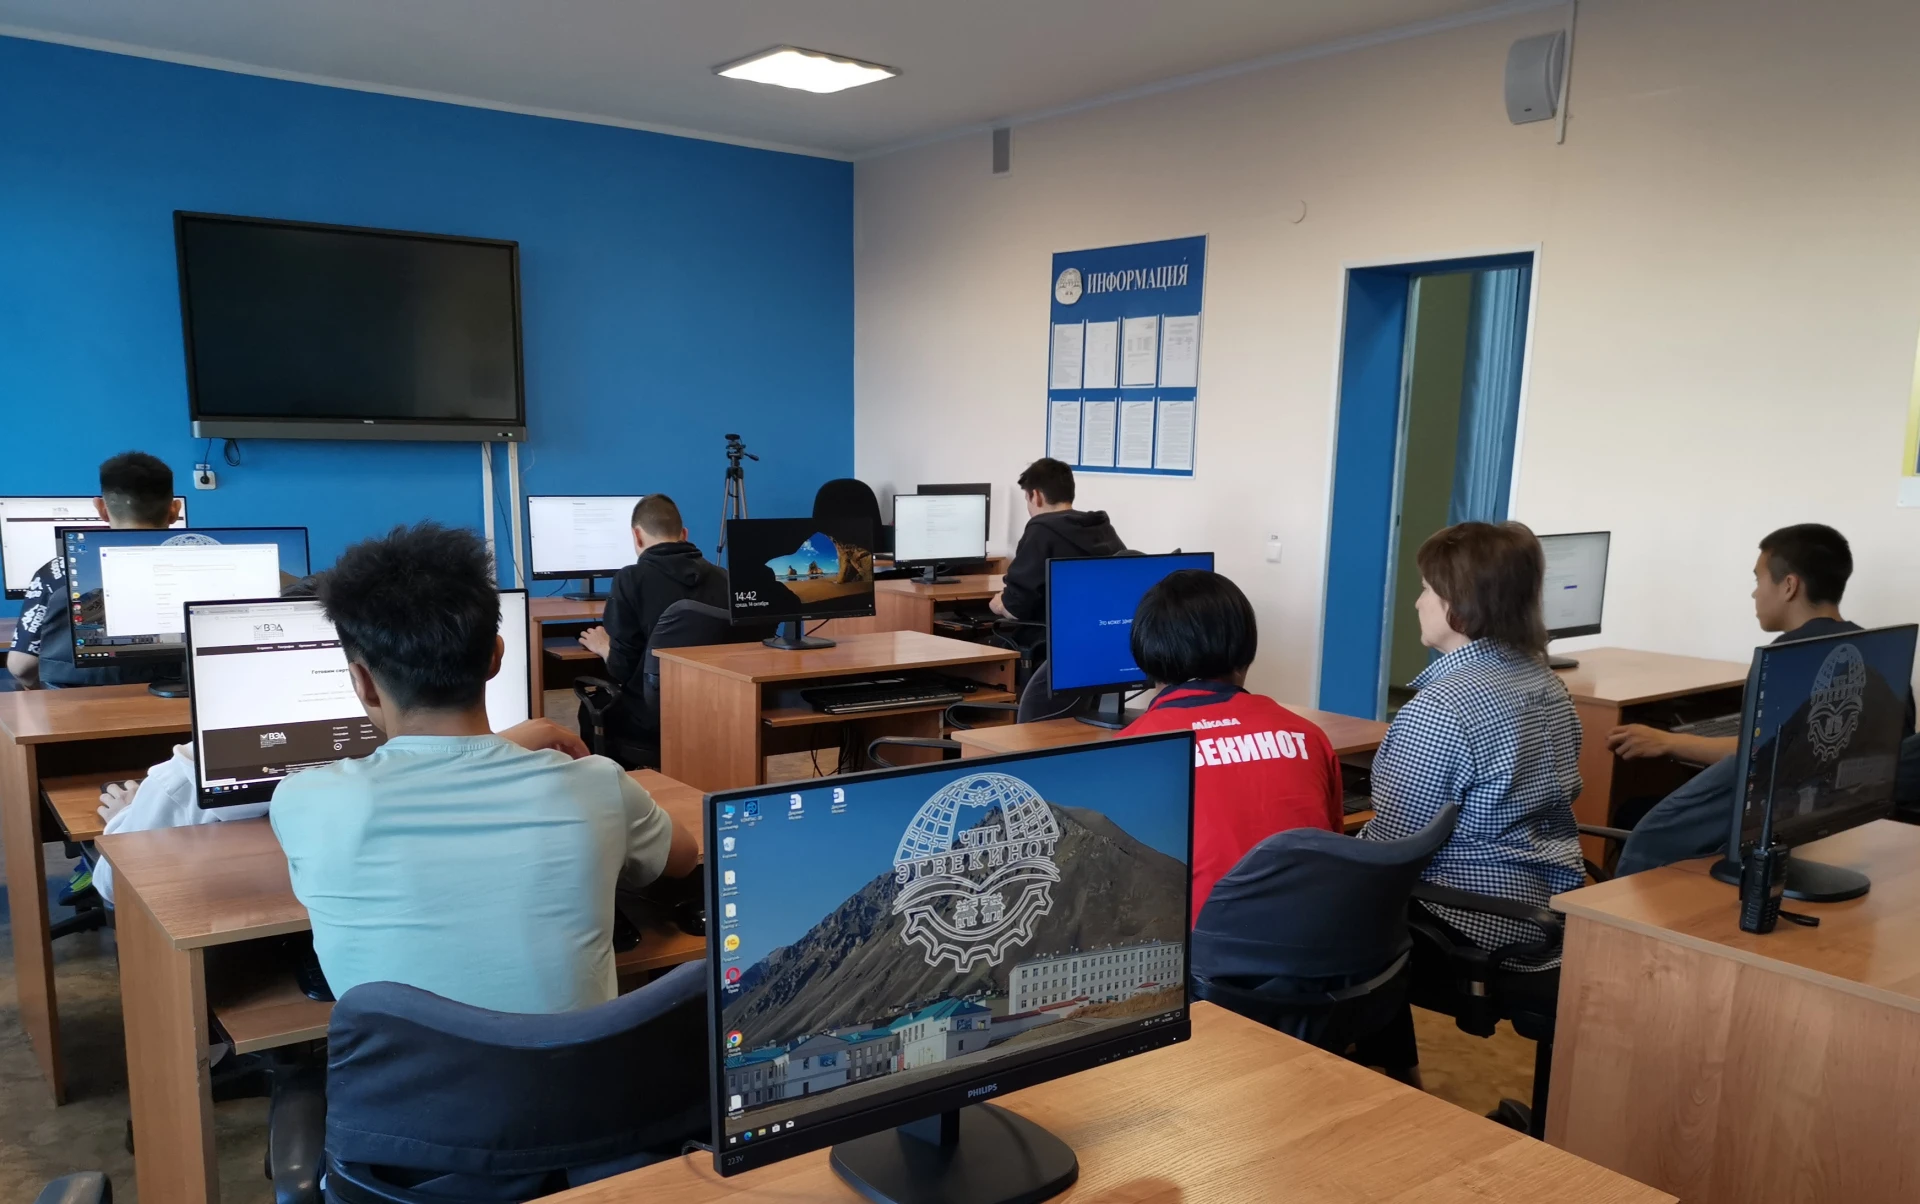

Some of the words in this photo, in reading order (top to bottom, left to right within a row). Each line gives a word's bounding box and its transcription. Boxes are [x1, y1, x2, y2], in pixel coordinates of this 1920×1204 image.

[1087, 264, 1188, 294] ИНФОРМАЦИЯ
[735, 591, 757, 601] 14:42
[1195, 730, 1308, 767] ВЕКИНОТ
[958, 825, 1000, 849] ЧПТ
[895, 837, 1058, 884] ЭГВЕКИНОТ
[967, 1083, 998, 1098] PHILIPS
